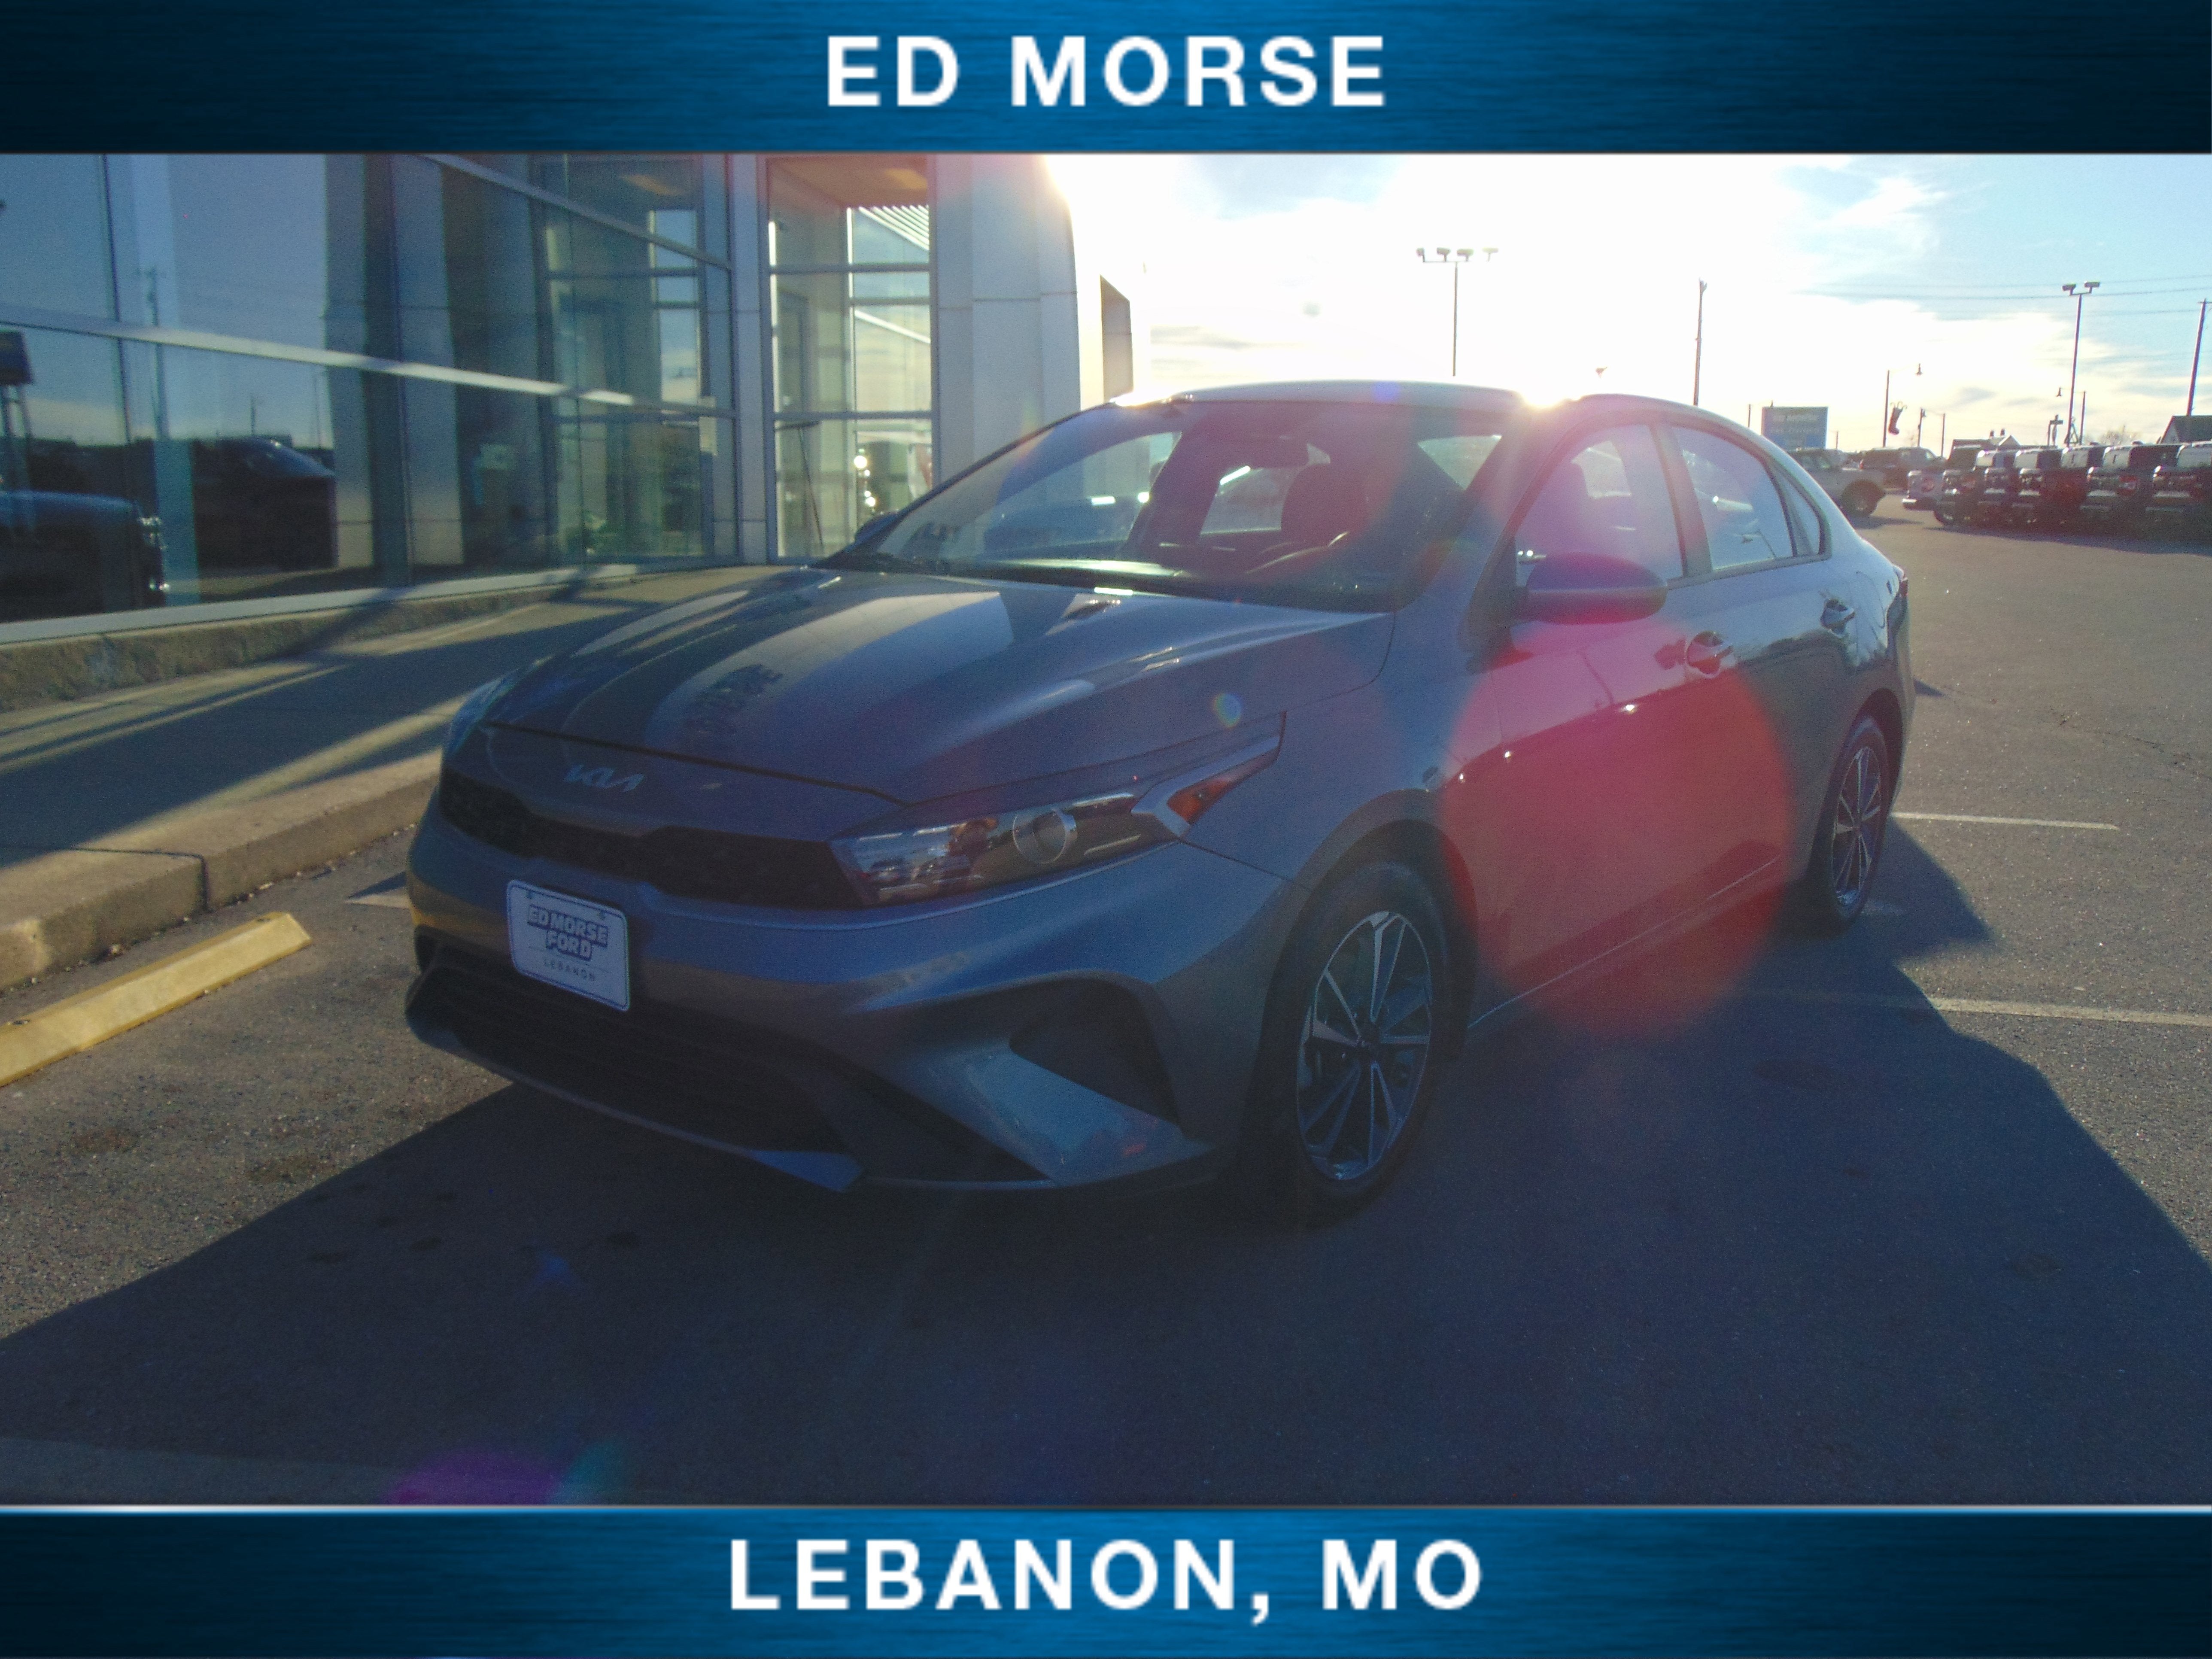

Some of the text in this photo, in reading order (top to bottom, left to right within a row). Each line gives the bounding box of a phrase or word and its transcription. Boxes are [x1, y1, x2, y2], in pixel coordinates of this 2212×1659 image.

[563, 764, 645, 793] KIA
[527, 904, 609, 948] ED MORSE
[546, 930, 594, 962] FORD
